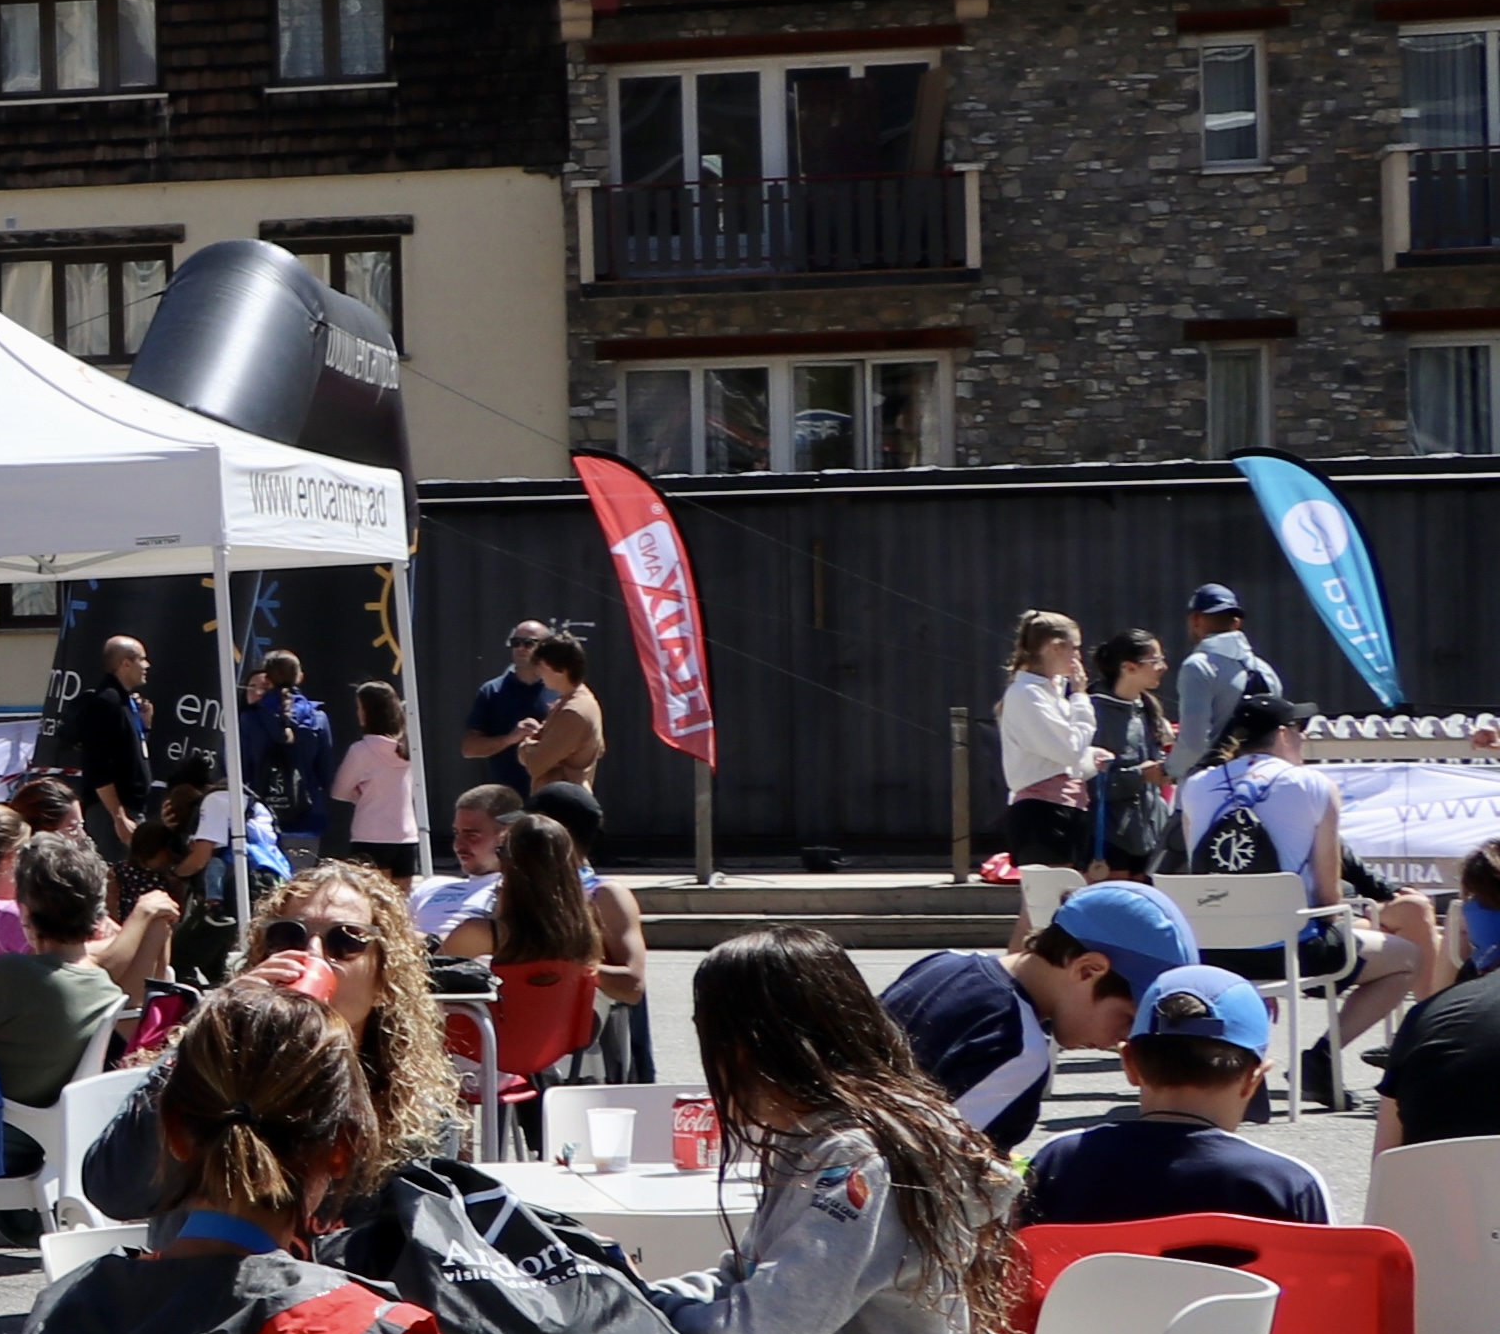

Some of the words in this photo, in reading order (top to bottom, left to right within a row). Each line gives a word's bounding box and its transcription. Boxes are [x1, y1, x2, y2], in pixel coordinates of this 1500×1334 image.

[250, 471, 388, 538] www.encamp.ad
[673, 1102, 716, 1133] Cola
[441, 1239, 574, 1278] Andorr
